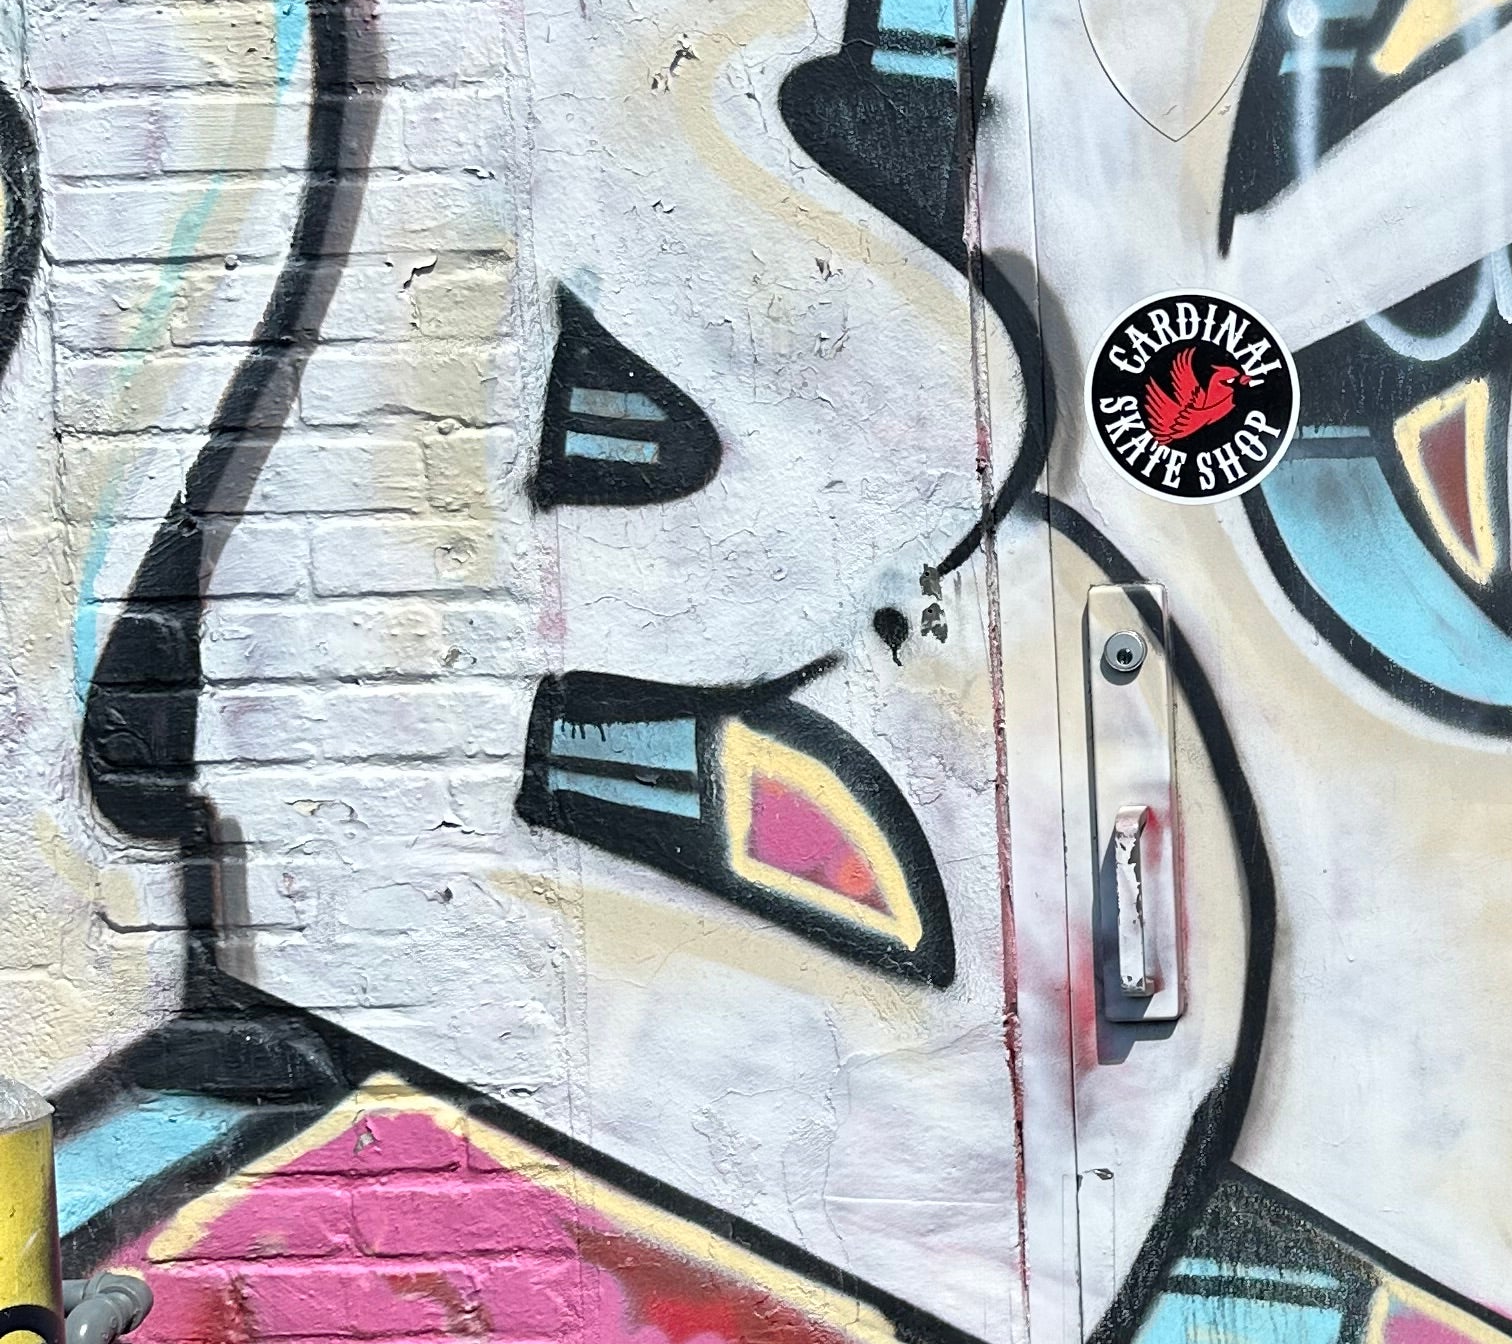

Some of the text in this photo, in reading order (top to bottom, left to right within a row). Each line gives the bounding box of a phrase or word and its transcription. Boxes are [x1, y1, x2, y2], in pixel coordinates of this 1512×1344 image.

[1109, 302, 1283, 387] CARDINAL
[1099, 395, 1282, 491] SKATE SHOP
